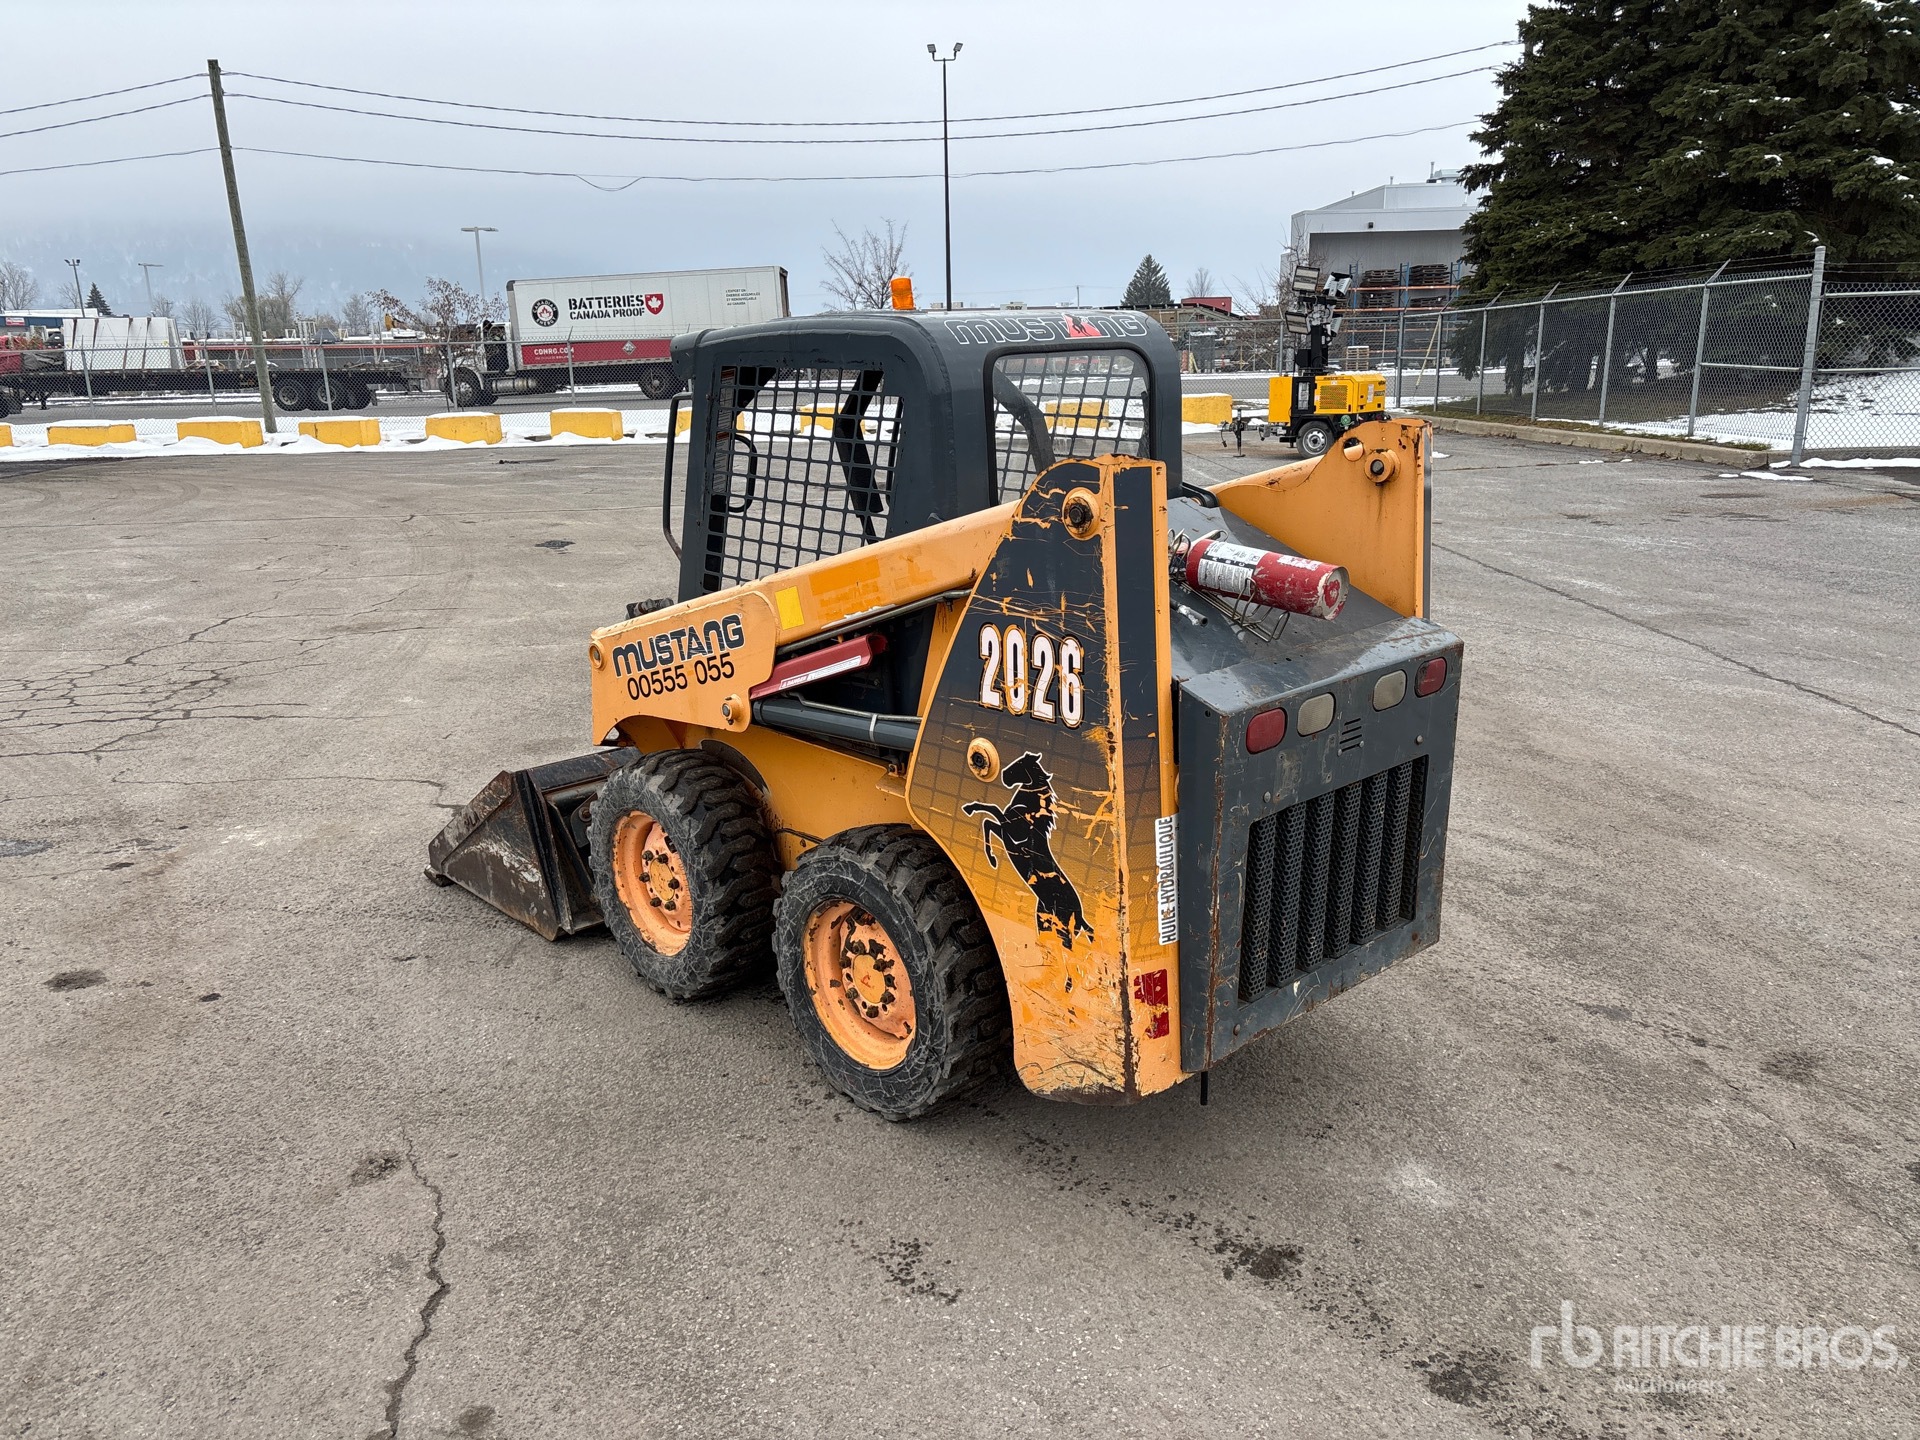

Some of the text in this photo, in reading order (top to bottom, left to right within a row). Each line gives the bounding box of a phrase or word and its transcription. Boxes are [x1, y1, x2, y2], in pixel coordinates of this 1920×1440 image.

[568, 295, 645, 310] BATTERIES
[569, 307, 645, 320] CANADA PROOF
[944, 313, 1148, 345] MUSTANG
[612, 615, 745, 677] MUSTANG
[627, 652, 735, 701] 00555 055
[979, 623, 1085, 729] 2026
[1158, 816, 1177, 944] HUILE HYDRAULIQUE
